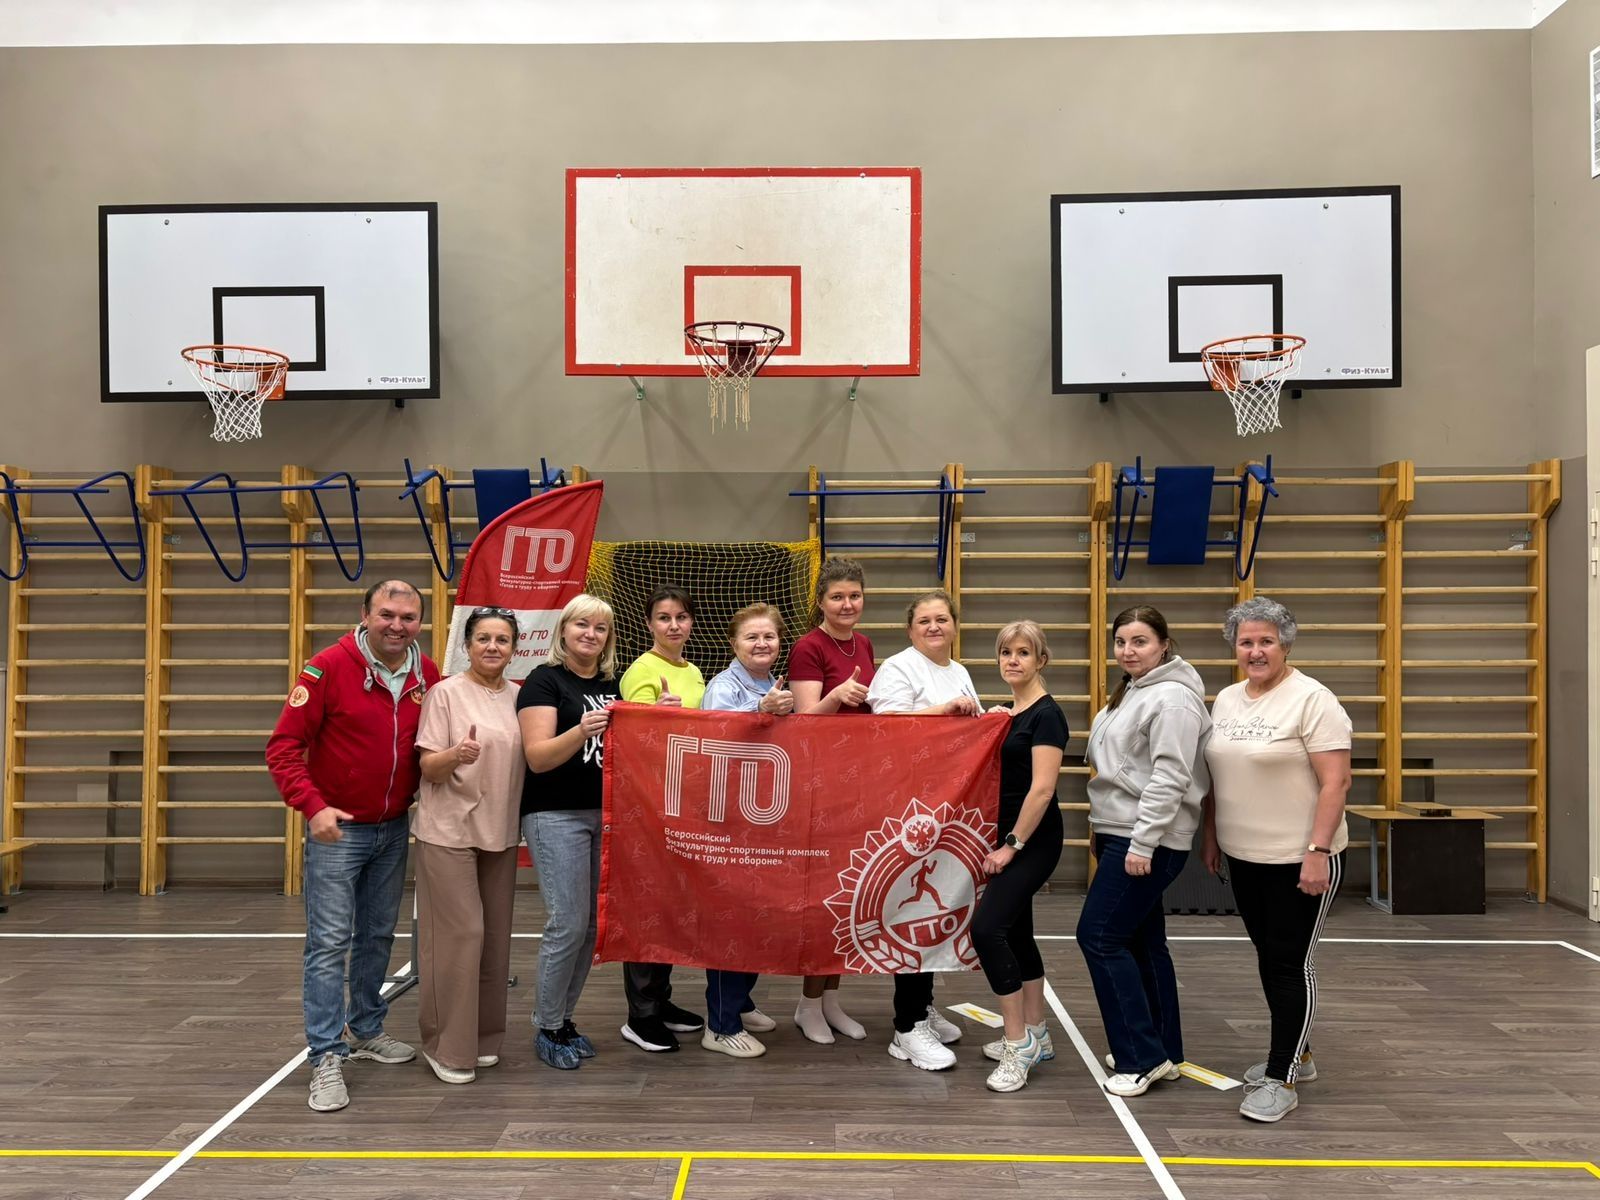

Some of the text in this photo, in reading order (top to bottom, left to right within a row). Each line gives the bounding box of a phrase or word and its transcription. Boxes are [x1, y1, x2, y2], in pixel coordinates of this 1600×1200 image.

[500, 525, 575, 574] ГТО
[529, 630, 549, 641] ГТО
[664, 733, 791, 825] ГТО
[664, 827, 731, 843] Всероссийский
[665, 844, 693, 859] «Готов
[694, 853, 700, 861] к
[702, 854, 729, 866] труду
[738, 855, 783, 867] обороне»
[786, 848, 830, 857] комплекс
[908, 914, 958, 945] ГТО
